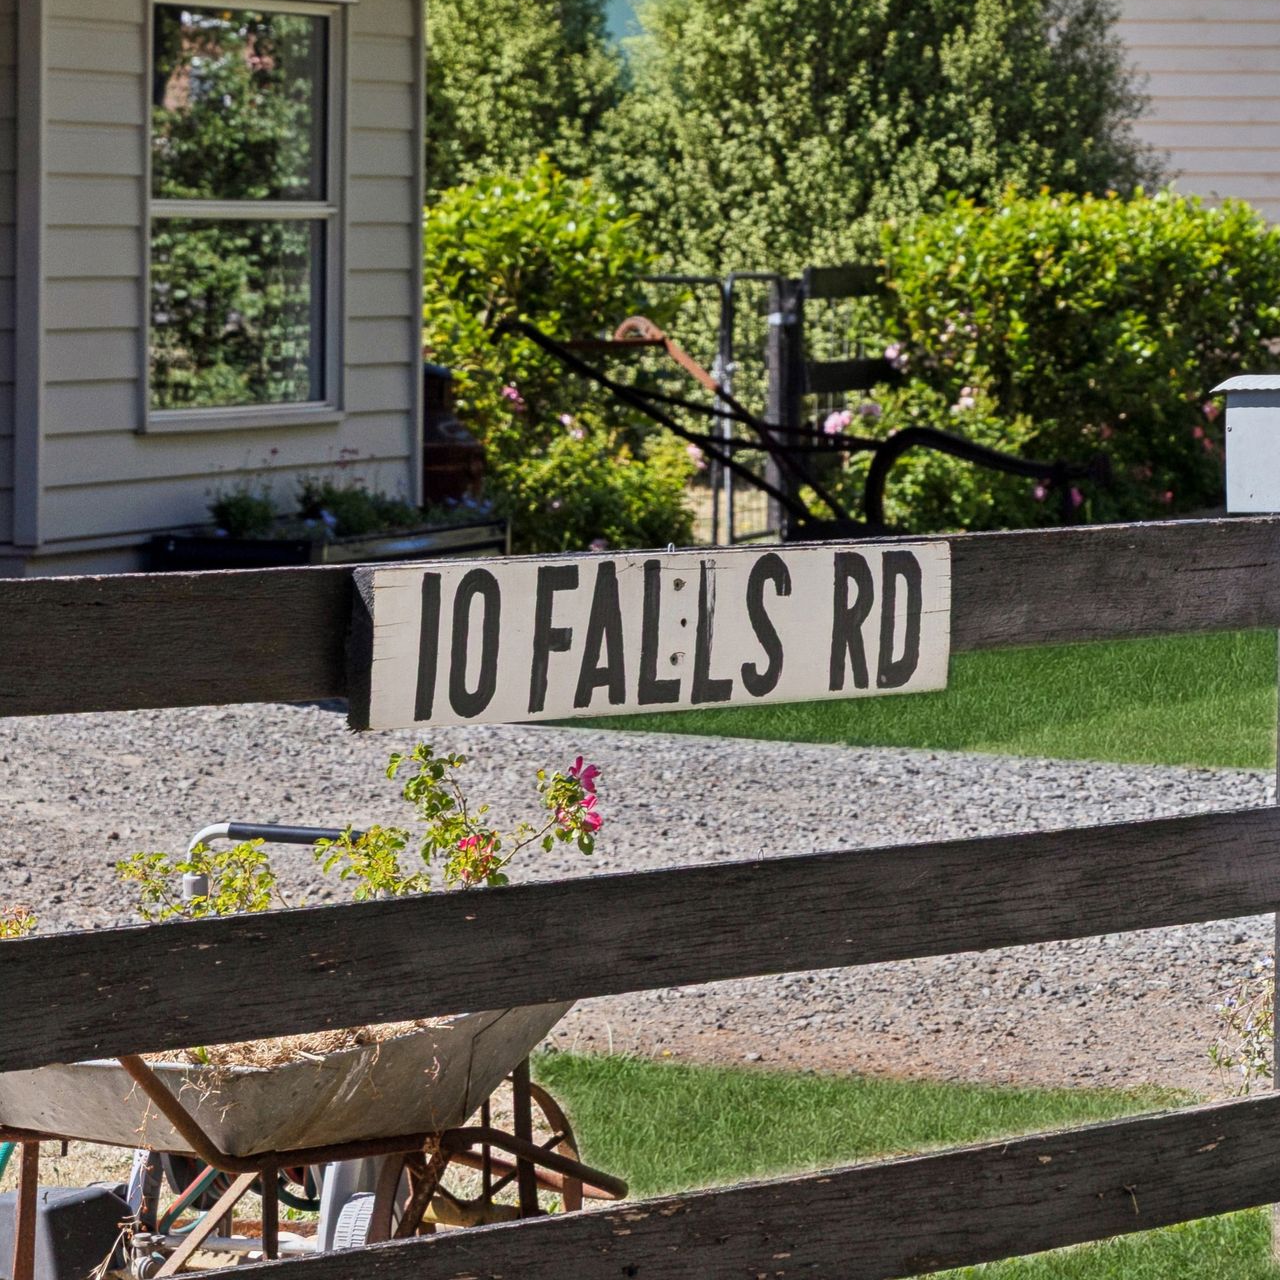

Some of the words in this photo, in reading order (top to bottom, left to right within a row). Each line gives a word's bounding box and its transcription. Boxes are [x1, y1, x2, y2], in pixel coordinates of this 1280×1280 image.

[414, 568, 502, 721] 10
[528, 552, 792, 714] FALLS
[829, 550, 923, 691] RD
